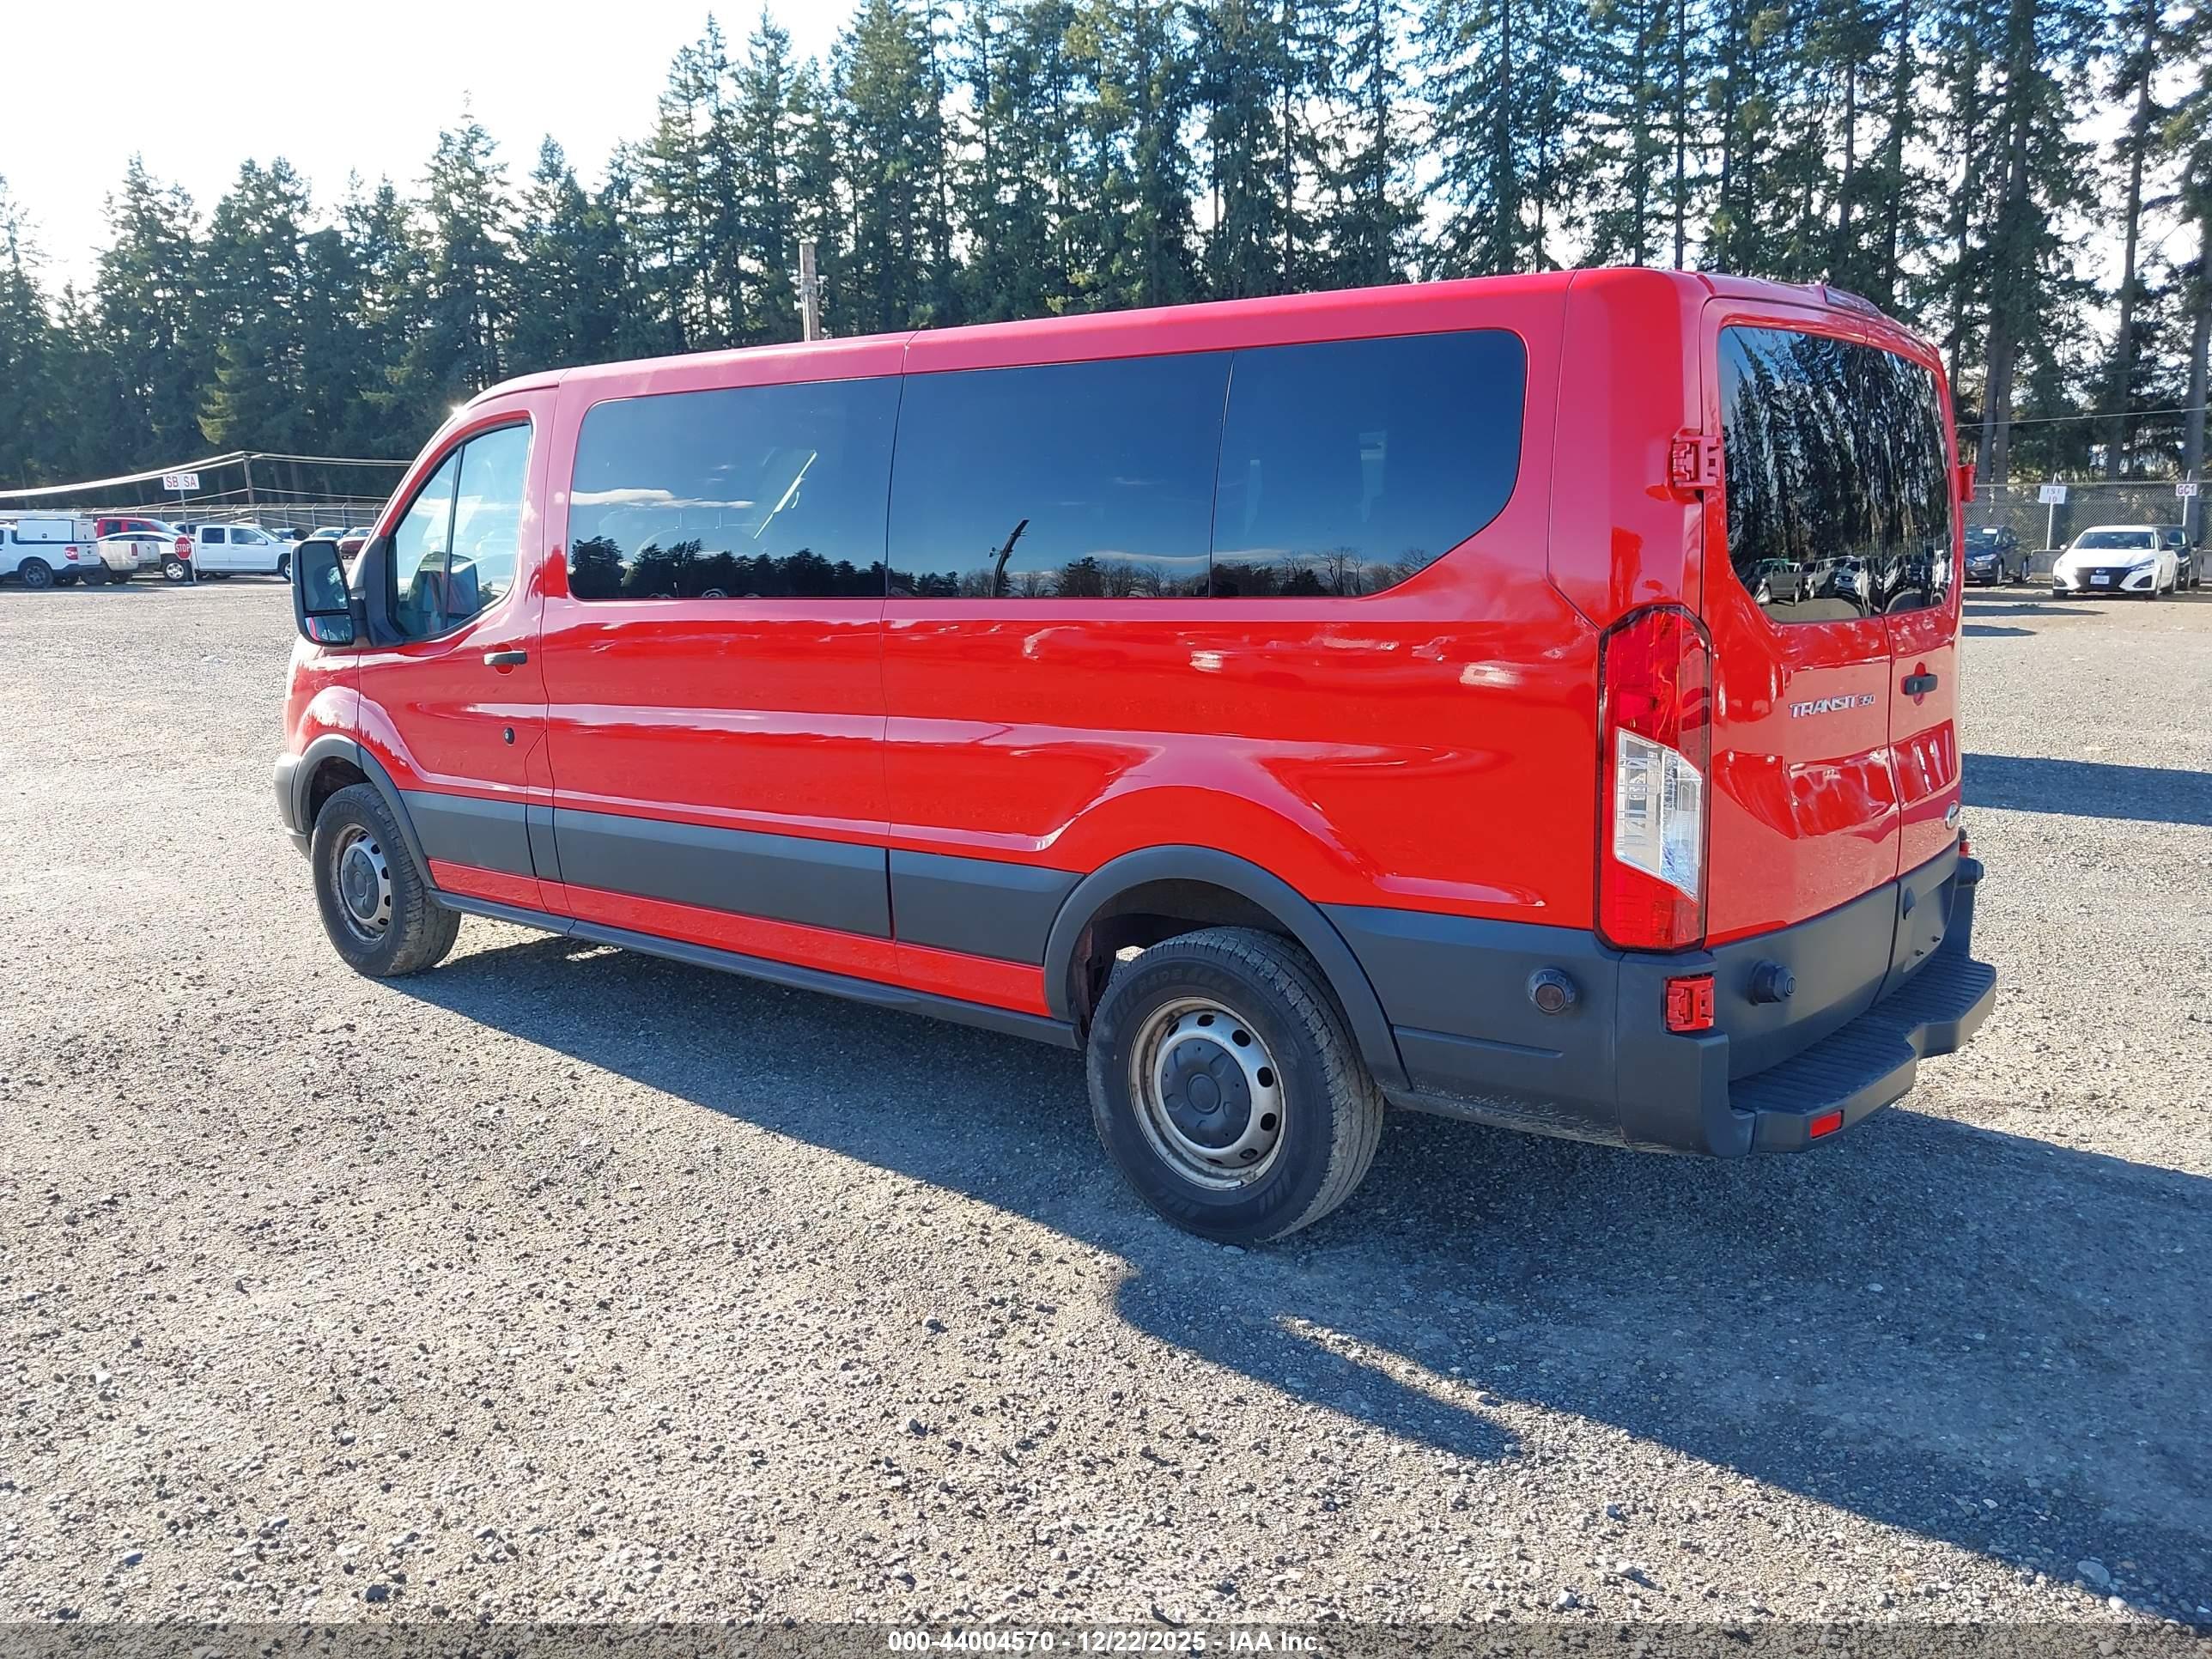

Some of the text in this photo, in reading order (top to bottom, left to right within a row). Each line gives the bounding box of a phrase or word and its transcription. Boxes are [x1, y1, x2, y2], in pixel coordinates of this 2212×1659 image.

[166, 476, 197, 488] SB SA
[2177, 484, 2195, 495] GC1
[175, 544, 191, 552] STOP
[1789, 695, 1859, 719] TRANSIT
